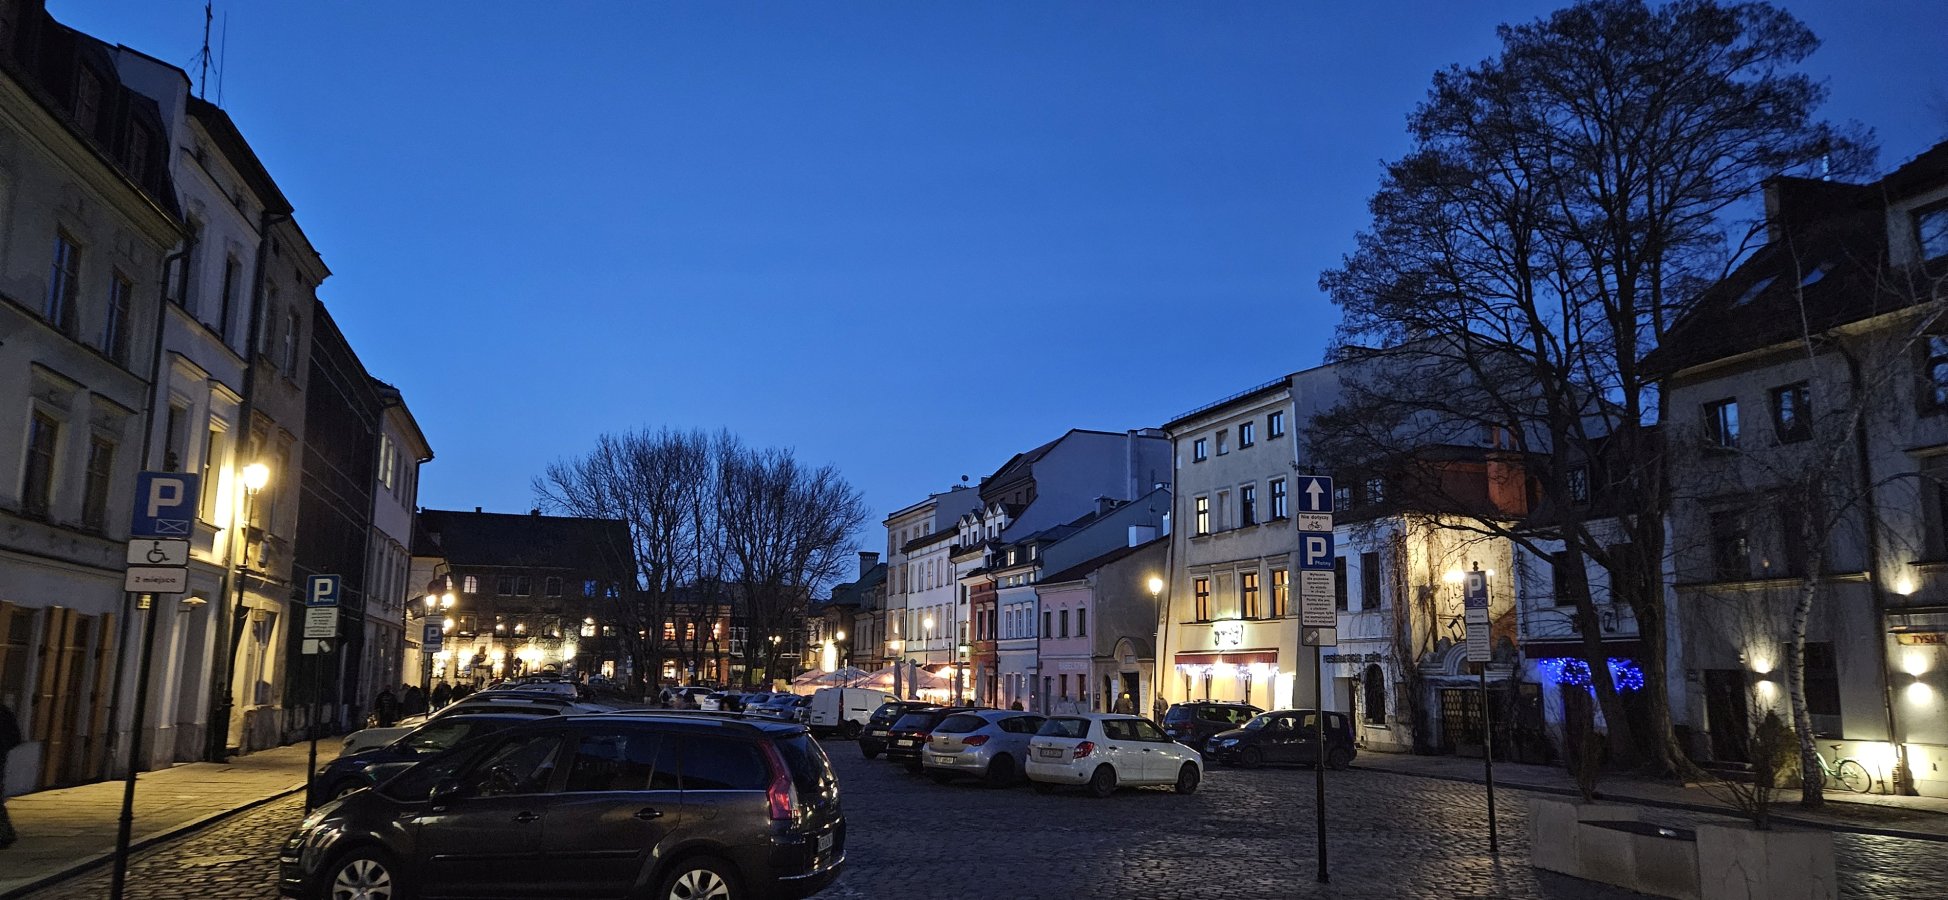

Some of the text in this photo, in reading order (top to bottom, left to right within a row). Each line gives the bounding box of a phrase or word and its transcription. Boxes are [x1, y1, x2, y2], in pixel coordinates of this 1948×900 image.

[147, 477, 184, 518] P
[1307, 537, 1326, 565] P
[314, 579, 333, 602] P
[1468, 575, 1482, 597] P
[427, 627, 439, 641] P
